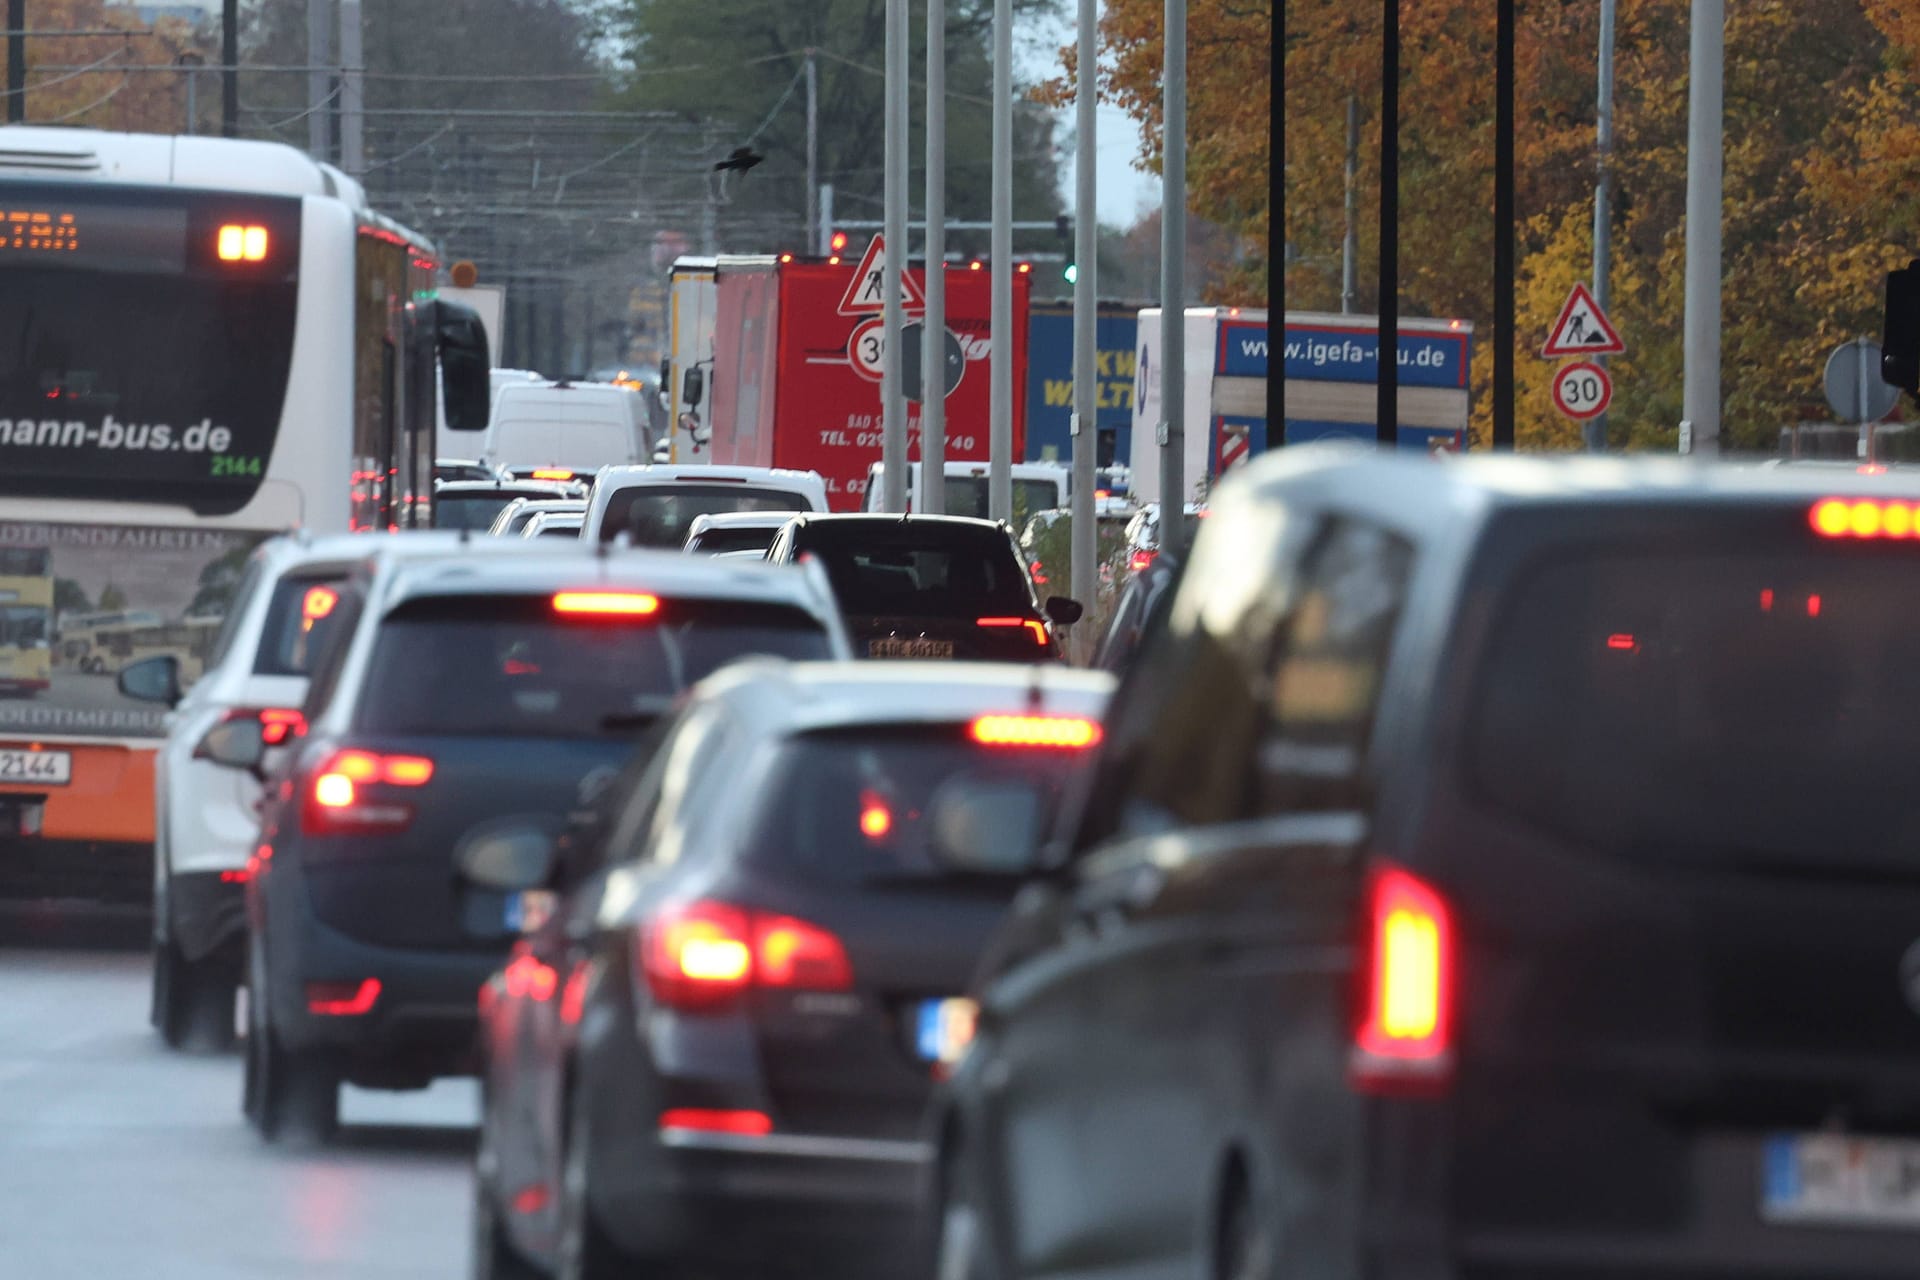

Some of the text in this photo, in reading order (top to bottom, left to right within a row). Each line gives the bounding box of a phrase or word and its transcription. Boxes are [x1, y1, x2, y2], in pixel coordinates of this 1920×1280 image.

[863, 337, 886, 364] 3
[1564, 377, 1598, 404] 30
[820, 430, 851, 446] TEL.
[210, 456, 261, 476] 2144
[0, 753, 57, 776] 2144
